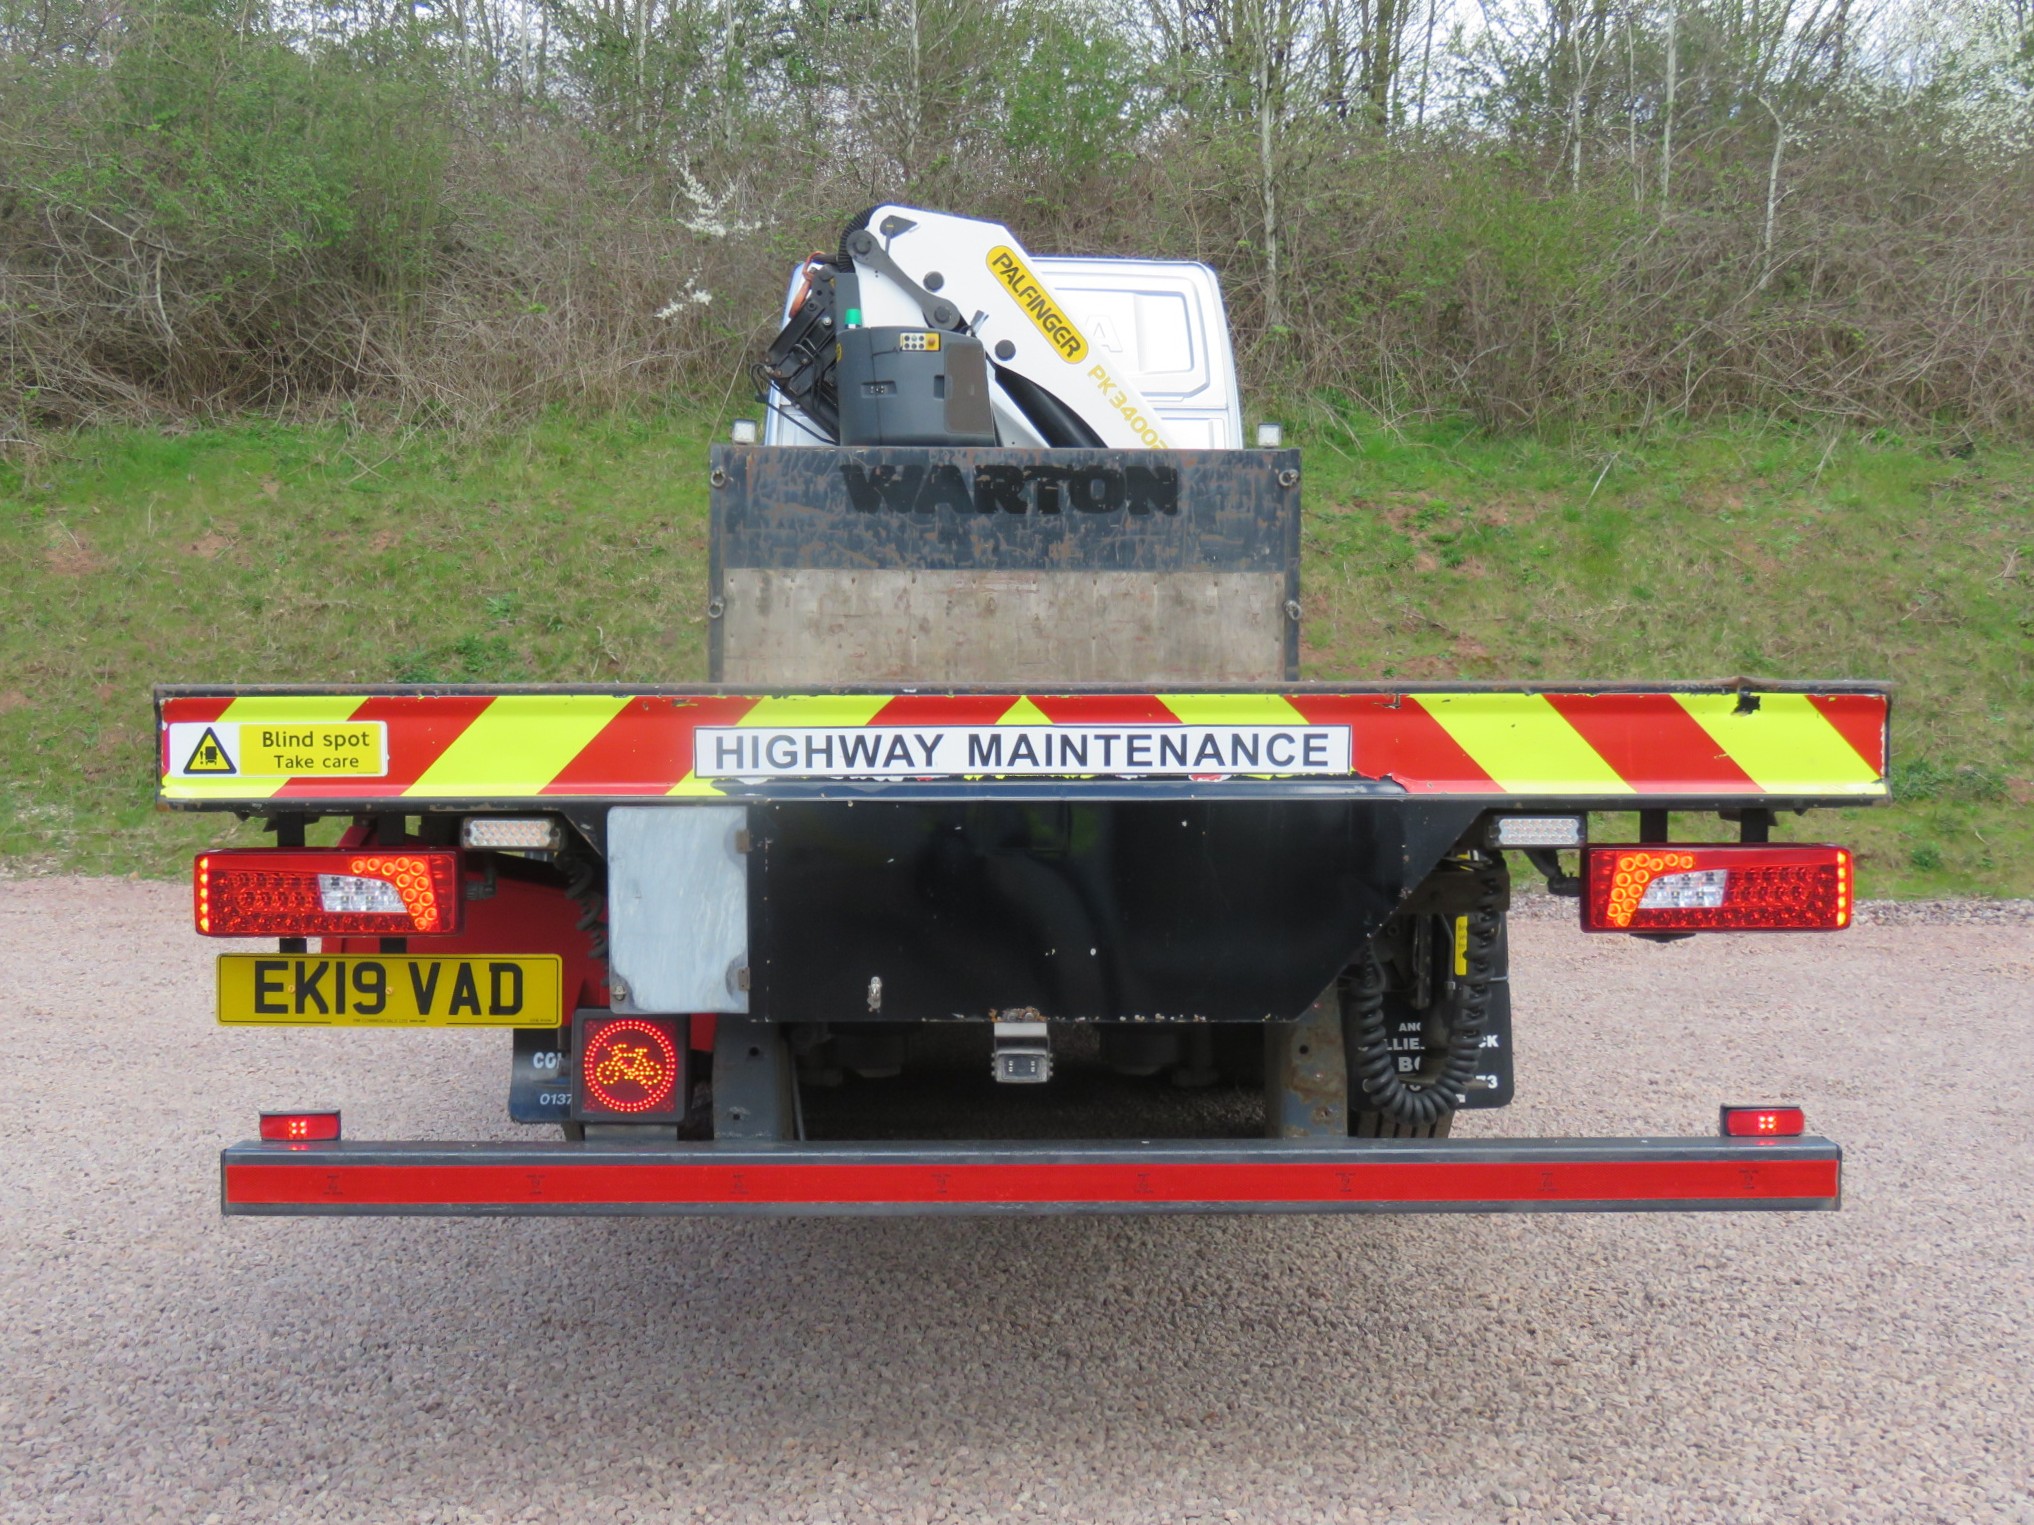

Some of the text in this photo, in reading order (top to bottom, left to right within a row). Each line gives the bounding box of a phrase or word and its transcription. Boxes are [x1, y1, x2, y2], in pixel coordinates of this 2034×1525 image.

[992, 252, 1081, 358] PALFINGER
[1087, 364, 1118, 396] PK
[839, 464, 1178, 515] WARTON
[262, 731, 370, 751] Blind spot
[714, 732, 1330, 771] HIGHWAY MAINTENANCE
[274, 755, 359, 769] Take care
[254, 960, 524, 1016] EK19 VAD
